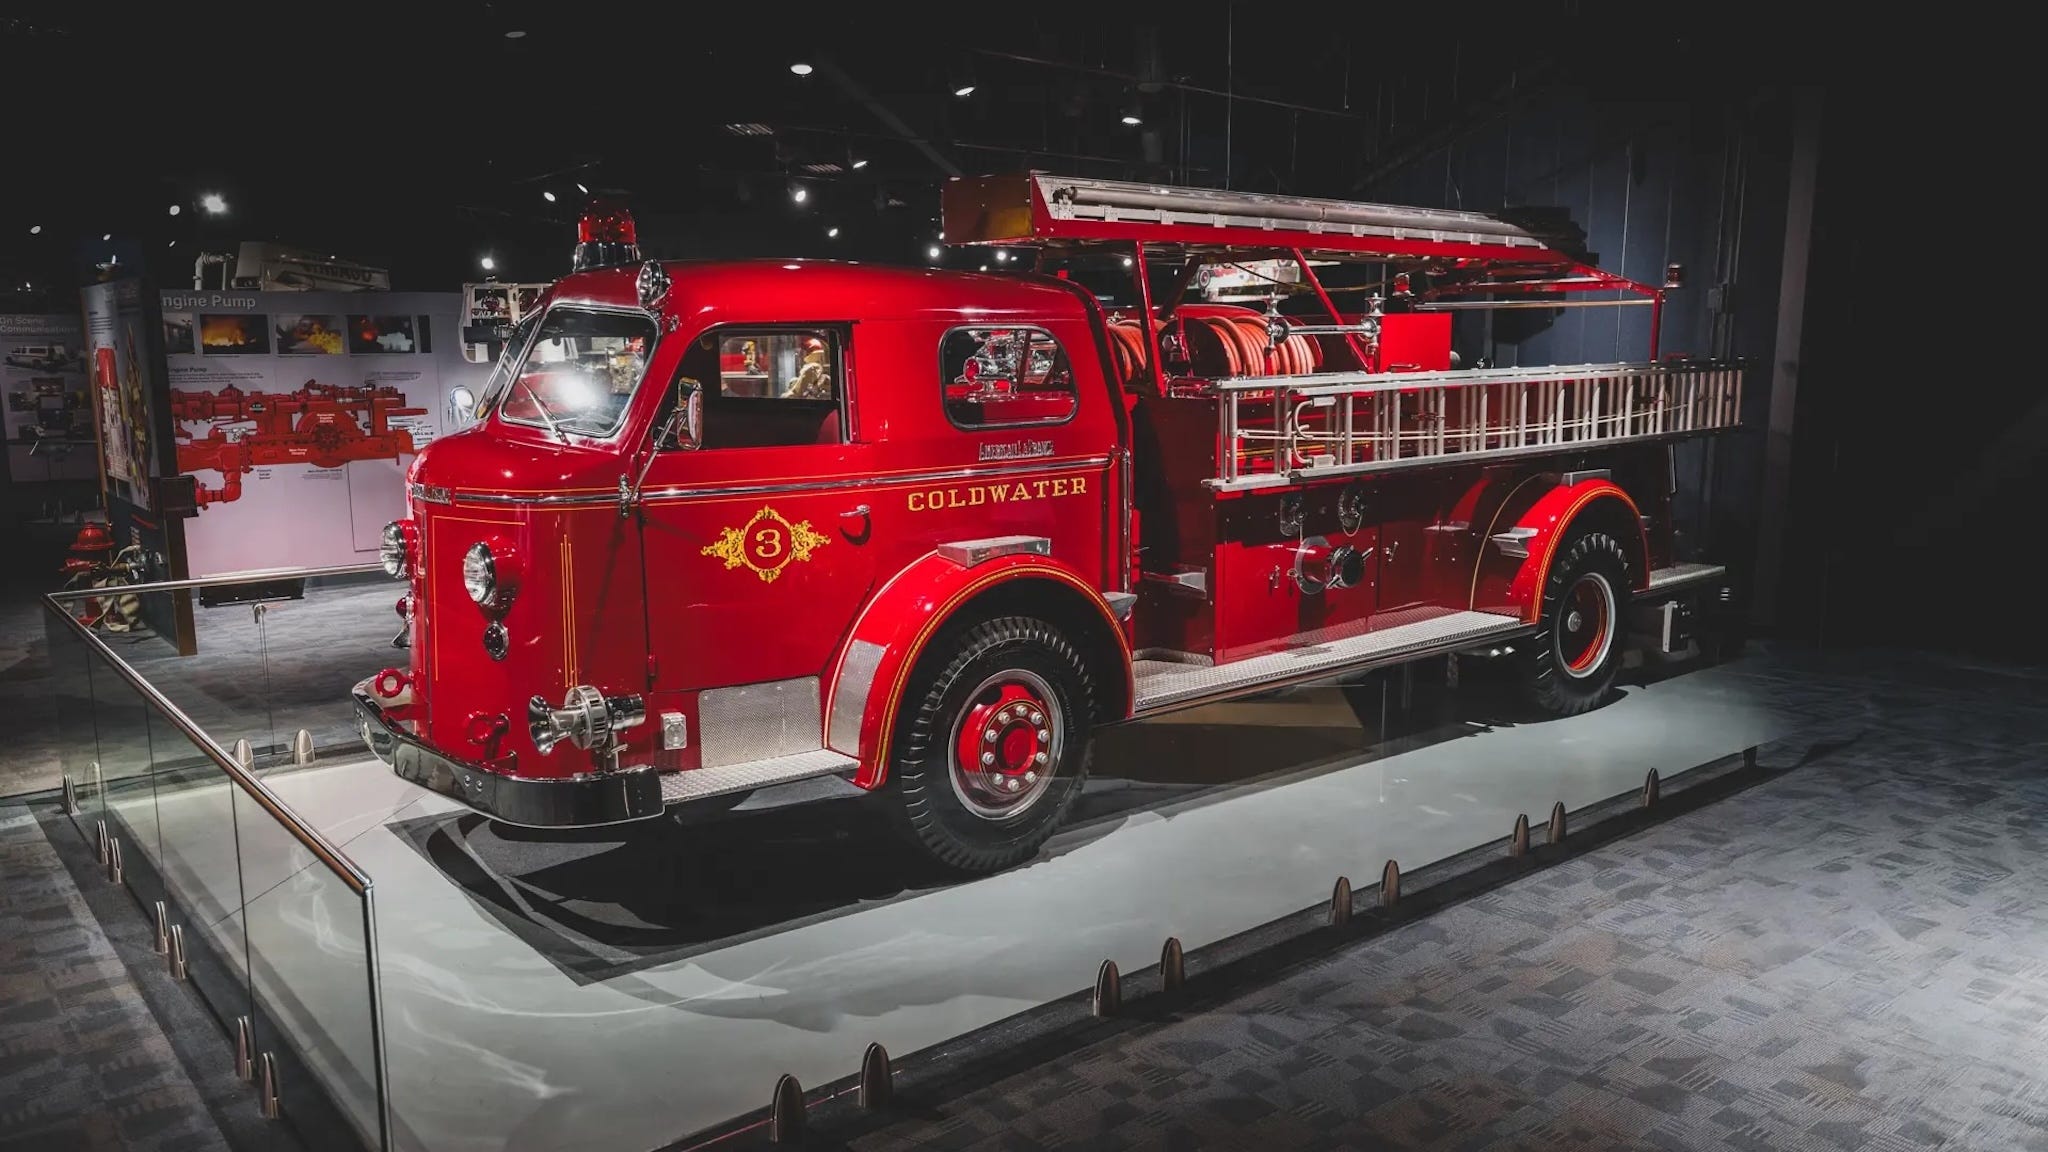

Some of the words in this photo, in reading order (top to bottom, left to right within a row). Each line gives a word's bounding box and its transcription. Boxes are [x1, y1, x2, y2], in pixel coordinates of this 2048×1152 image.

[162, 294, 207, 310] ngine
[212, 295, 256, 310] Pump
[907, 477, 1087, 512] COLDWATER
[755, 529, 781, 557] 3
